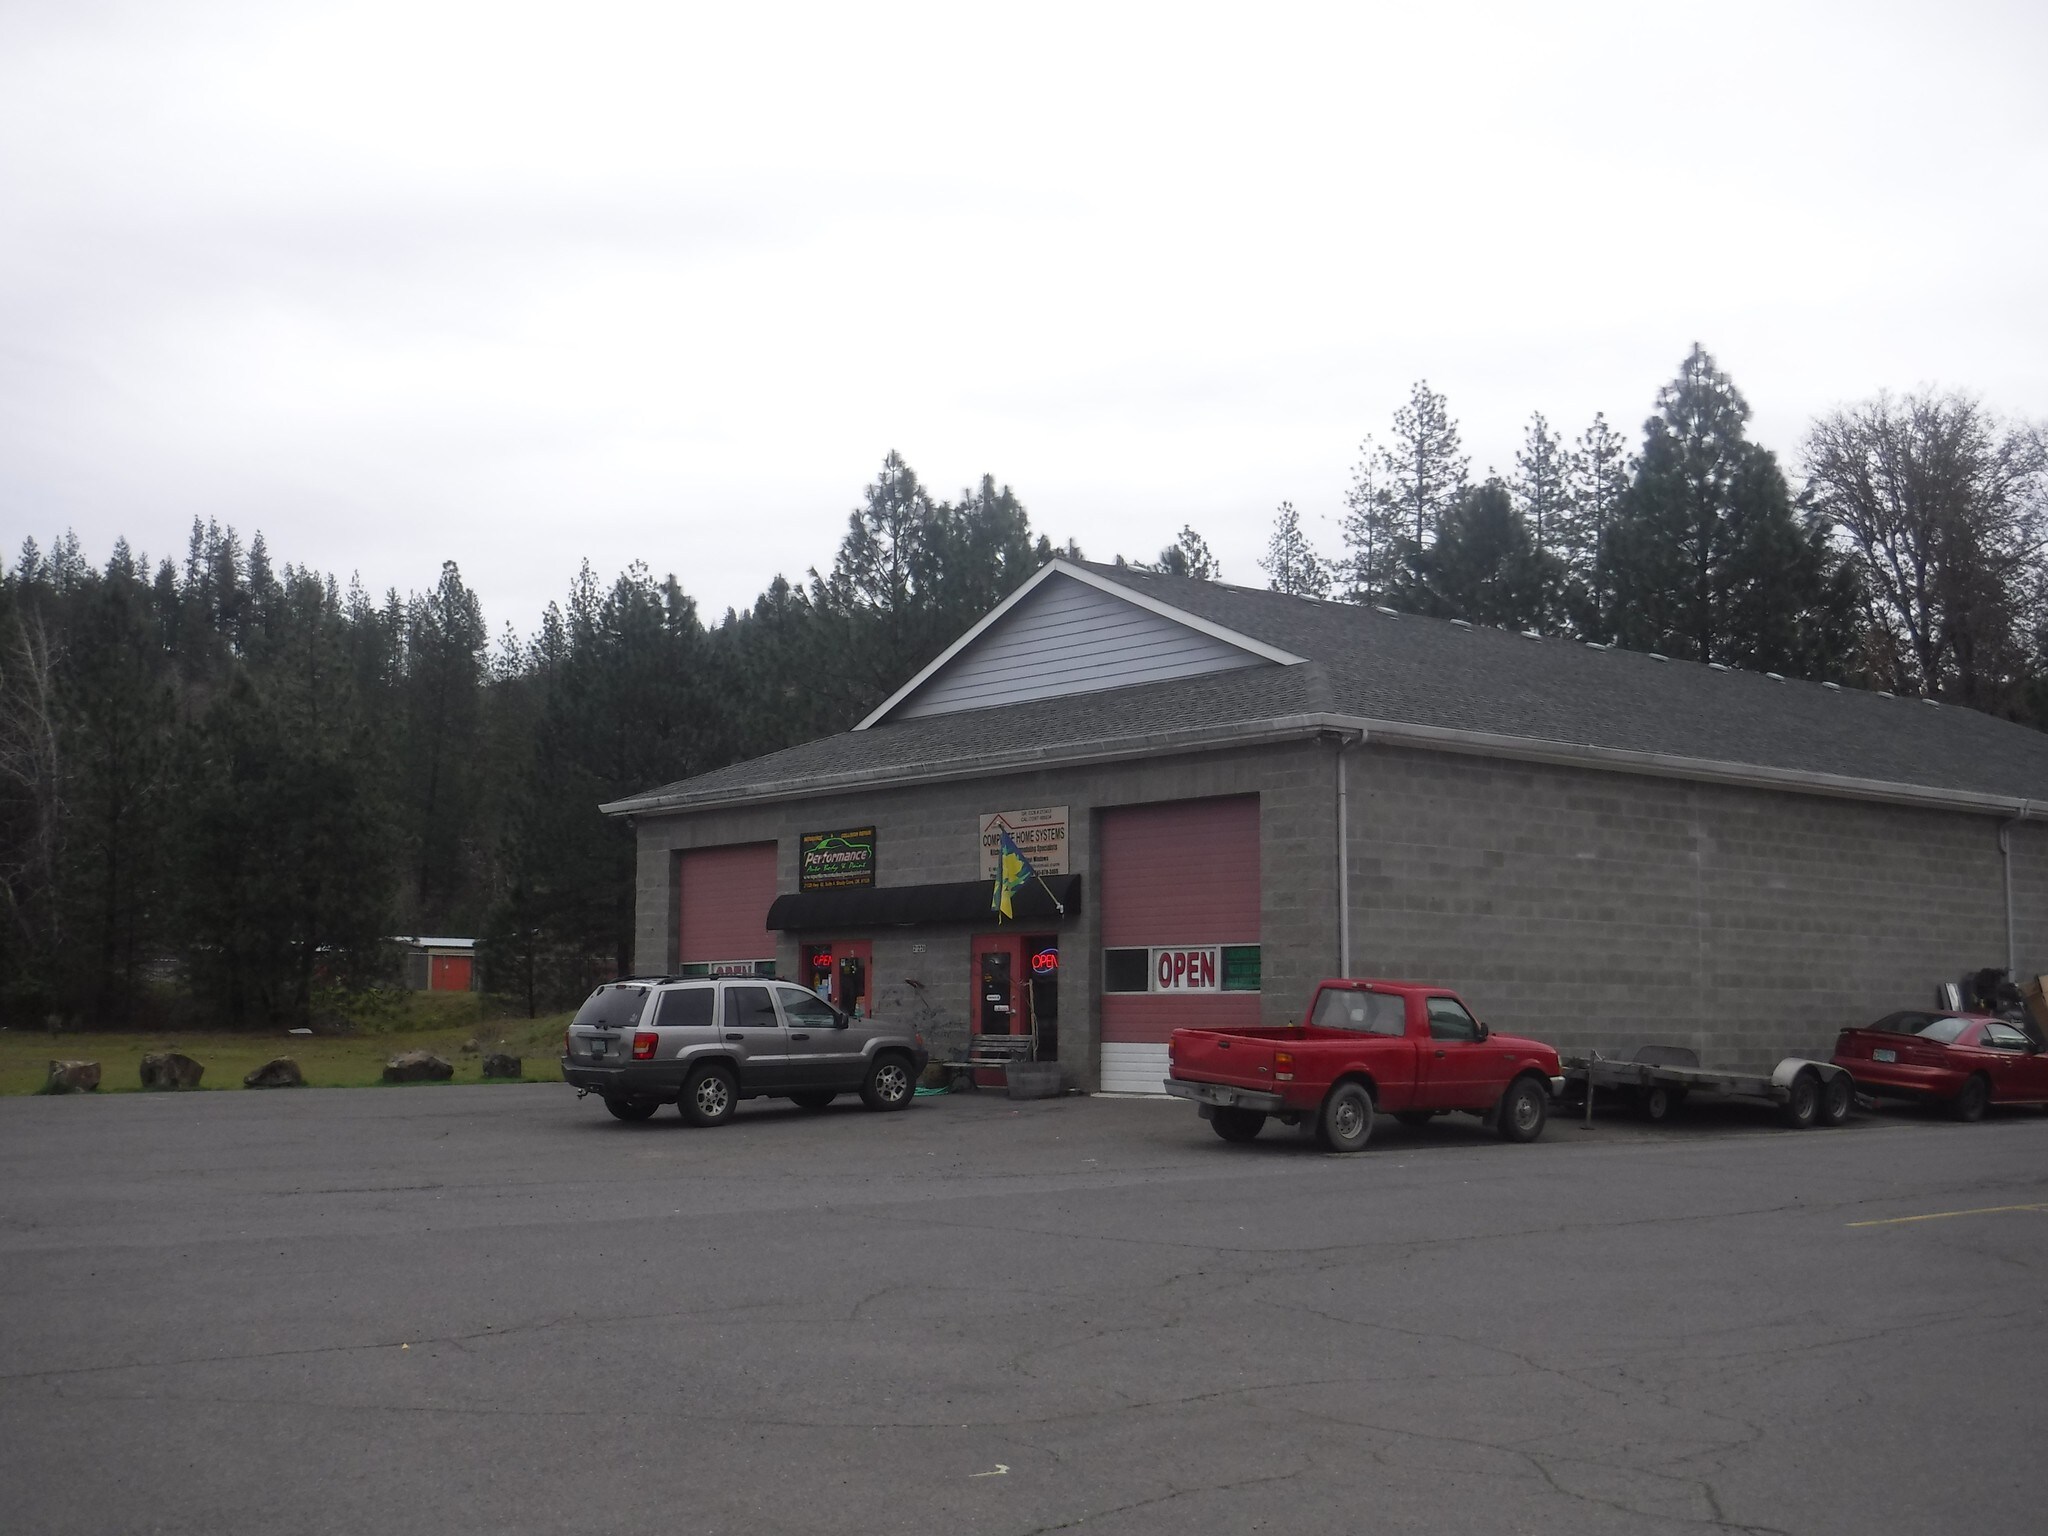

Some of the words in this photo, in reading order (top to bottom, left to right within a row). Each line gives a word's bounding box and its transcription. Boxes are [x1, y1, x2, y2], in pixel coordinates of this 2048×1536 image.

[983, 833, 1016, 846] COMPE
[1016, 830, 1034, 844] HOME
[1036, 827, 1064, 842] SYSTEMS
[805, 850, 867, 867] Performance
[1032, 954, 1058, 968] OPEN
[1158, 951, 1215, 989] OPEN
